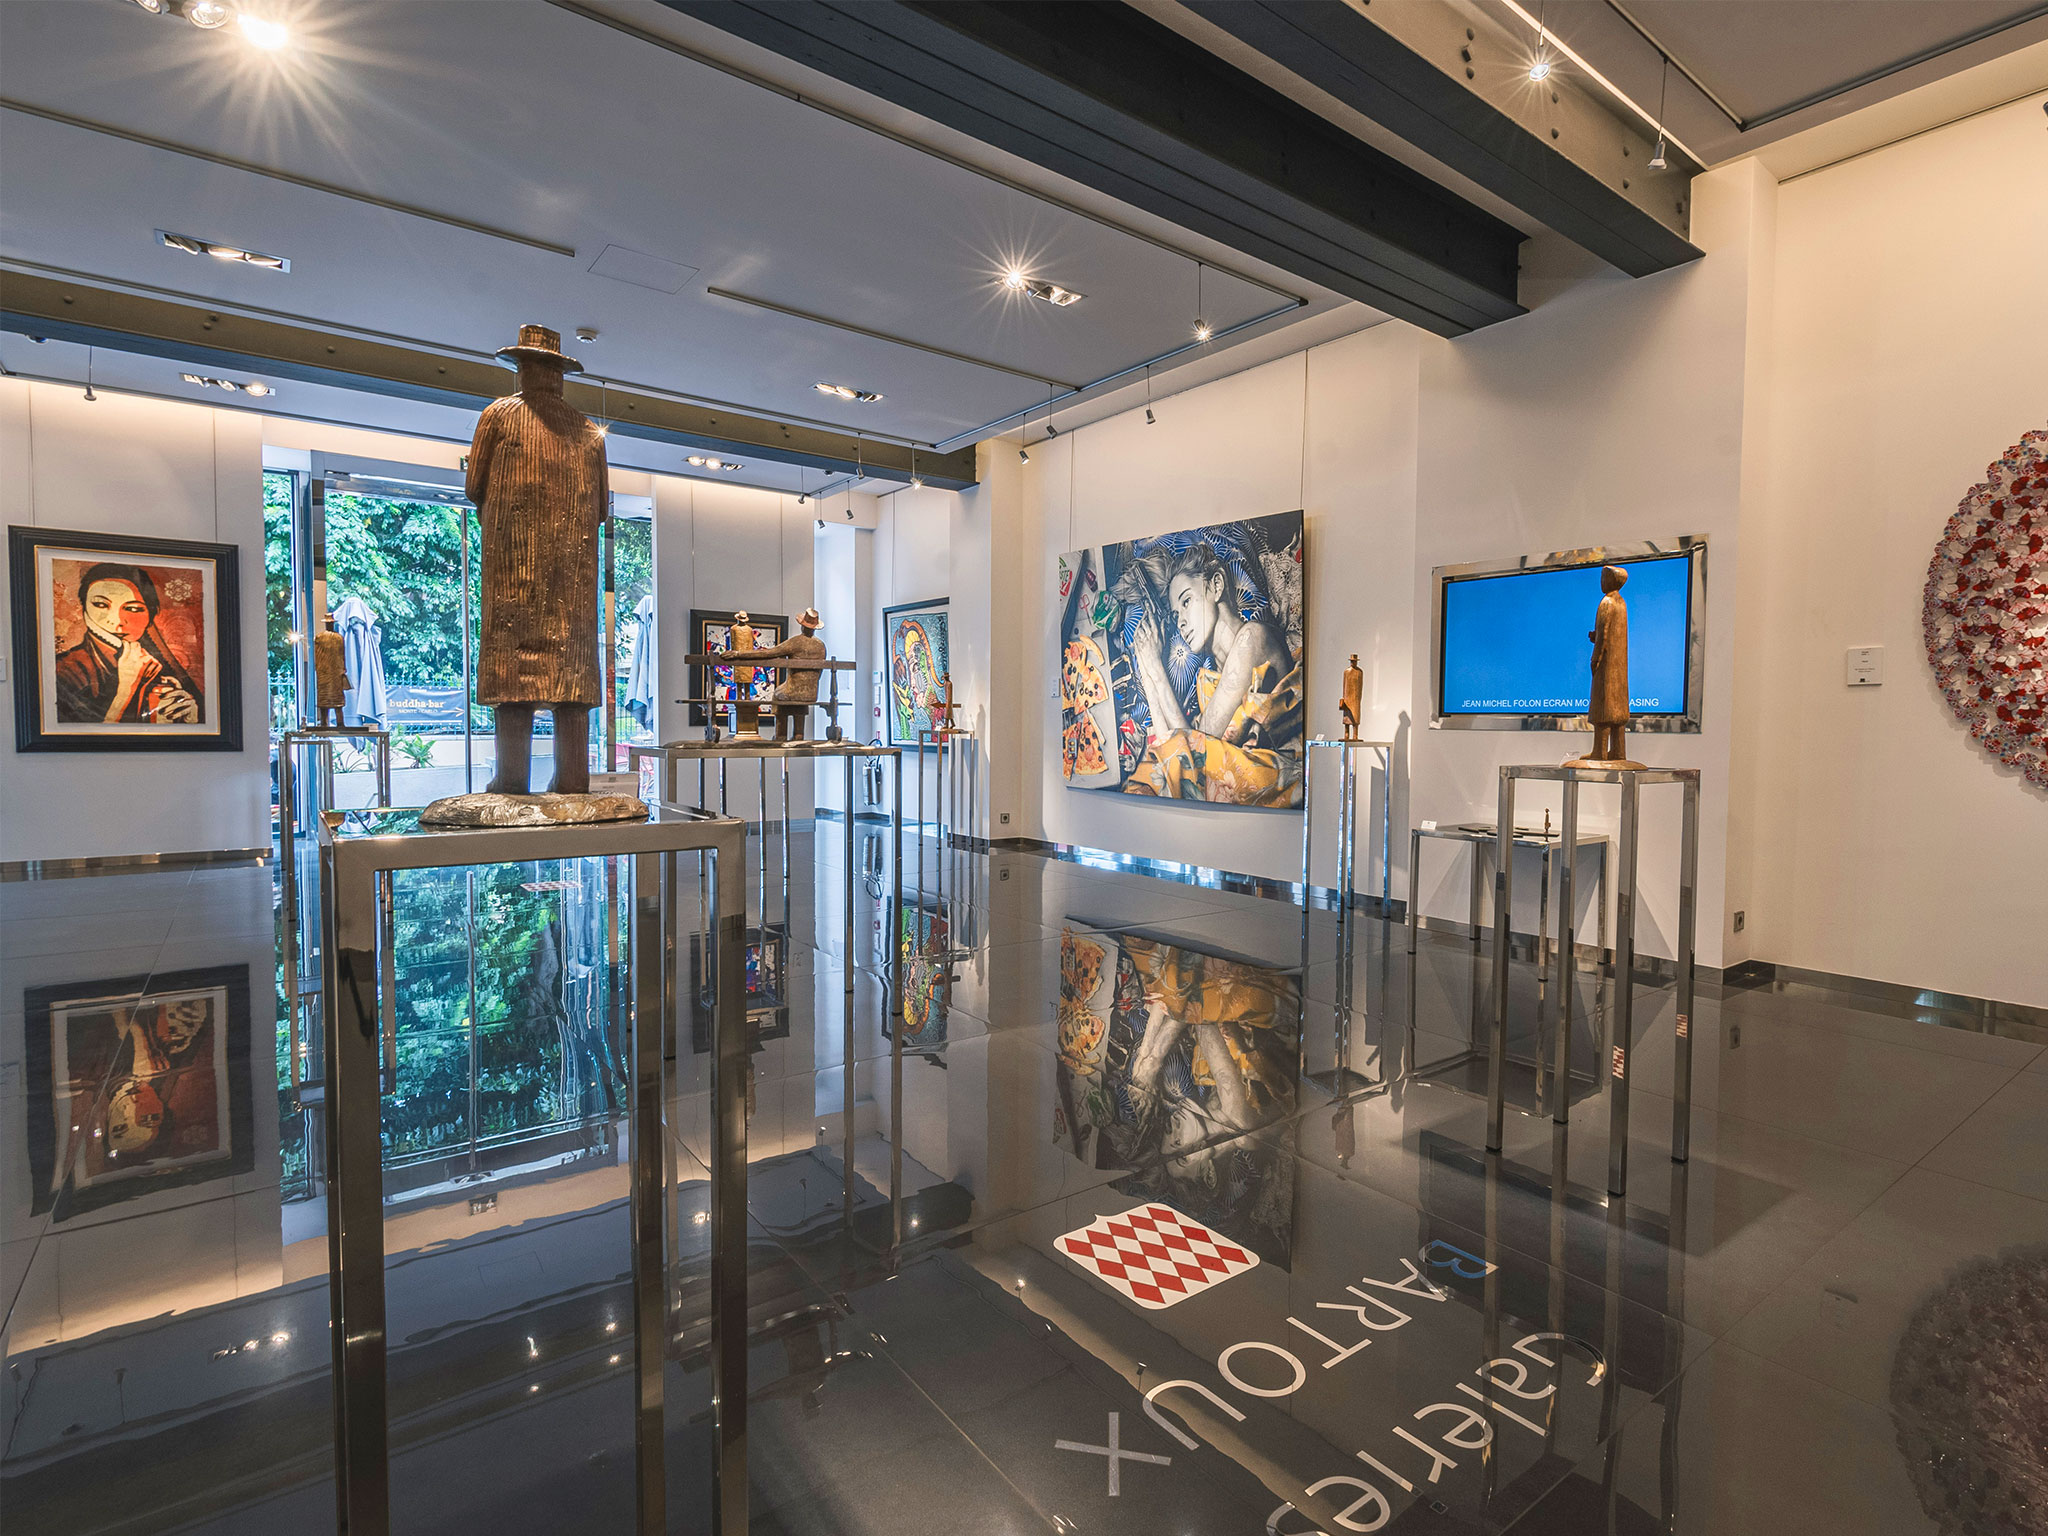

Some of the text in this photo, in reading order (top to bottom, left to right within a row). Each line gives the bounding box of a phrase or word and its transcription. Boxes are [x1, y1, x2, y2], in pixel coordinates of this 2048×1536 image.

[1461, 699, 1481, 708] JEAN
[1482, 699, 1512, 708] MICHEL
[1513, 699, 1541, 708] FOLON
[1543, 698, 1573, 707] ECRAN
[1629, 698, 1660, 707] ASING
[1053, 1238, 1500, 1498] BARTOUX
